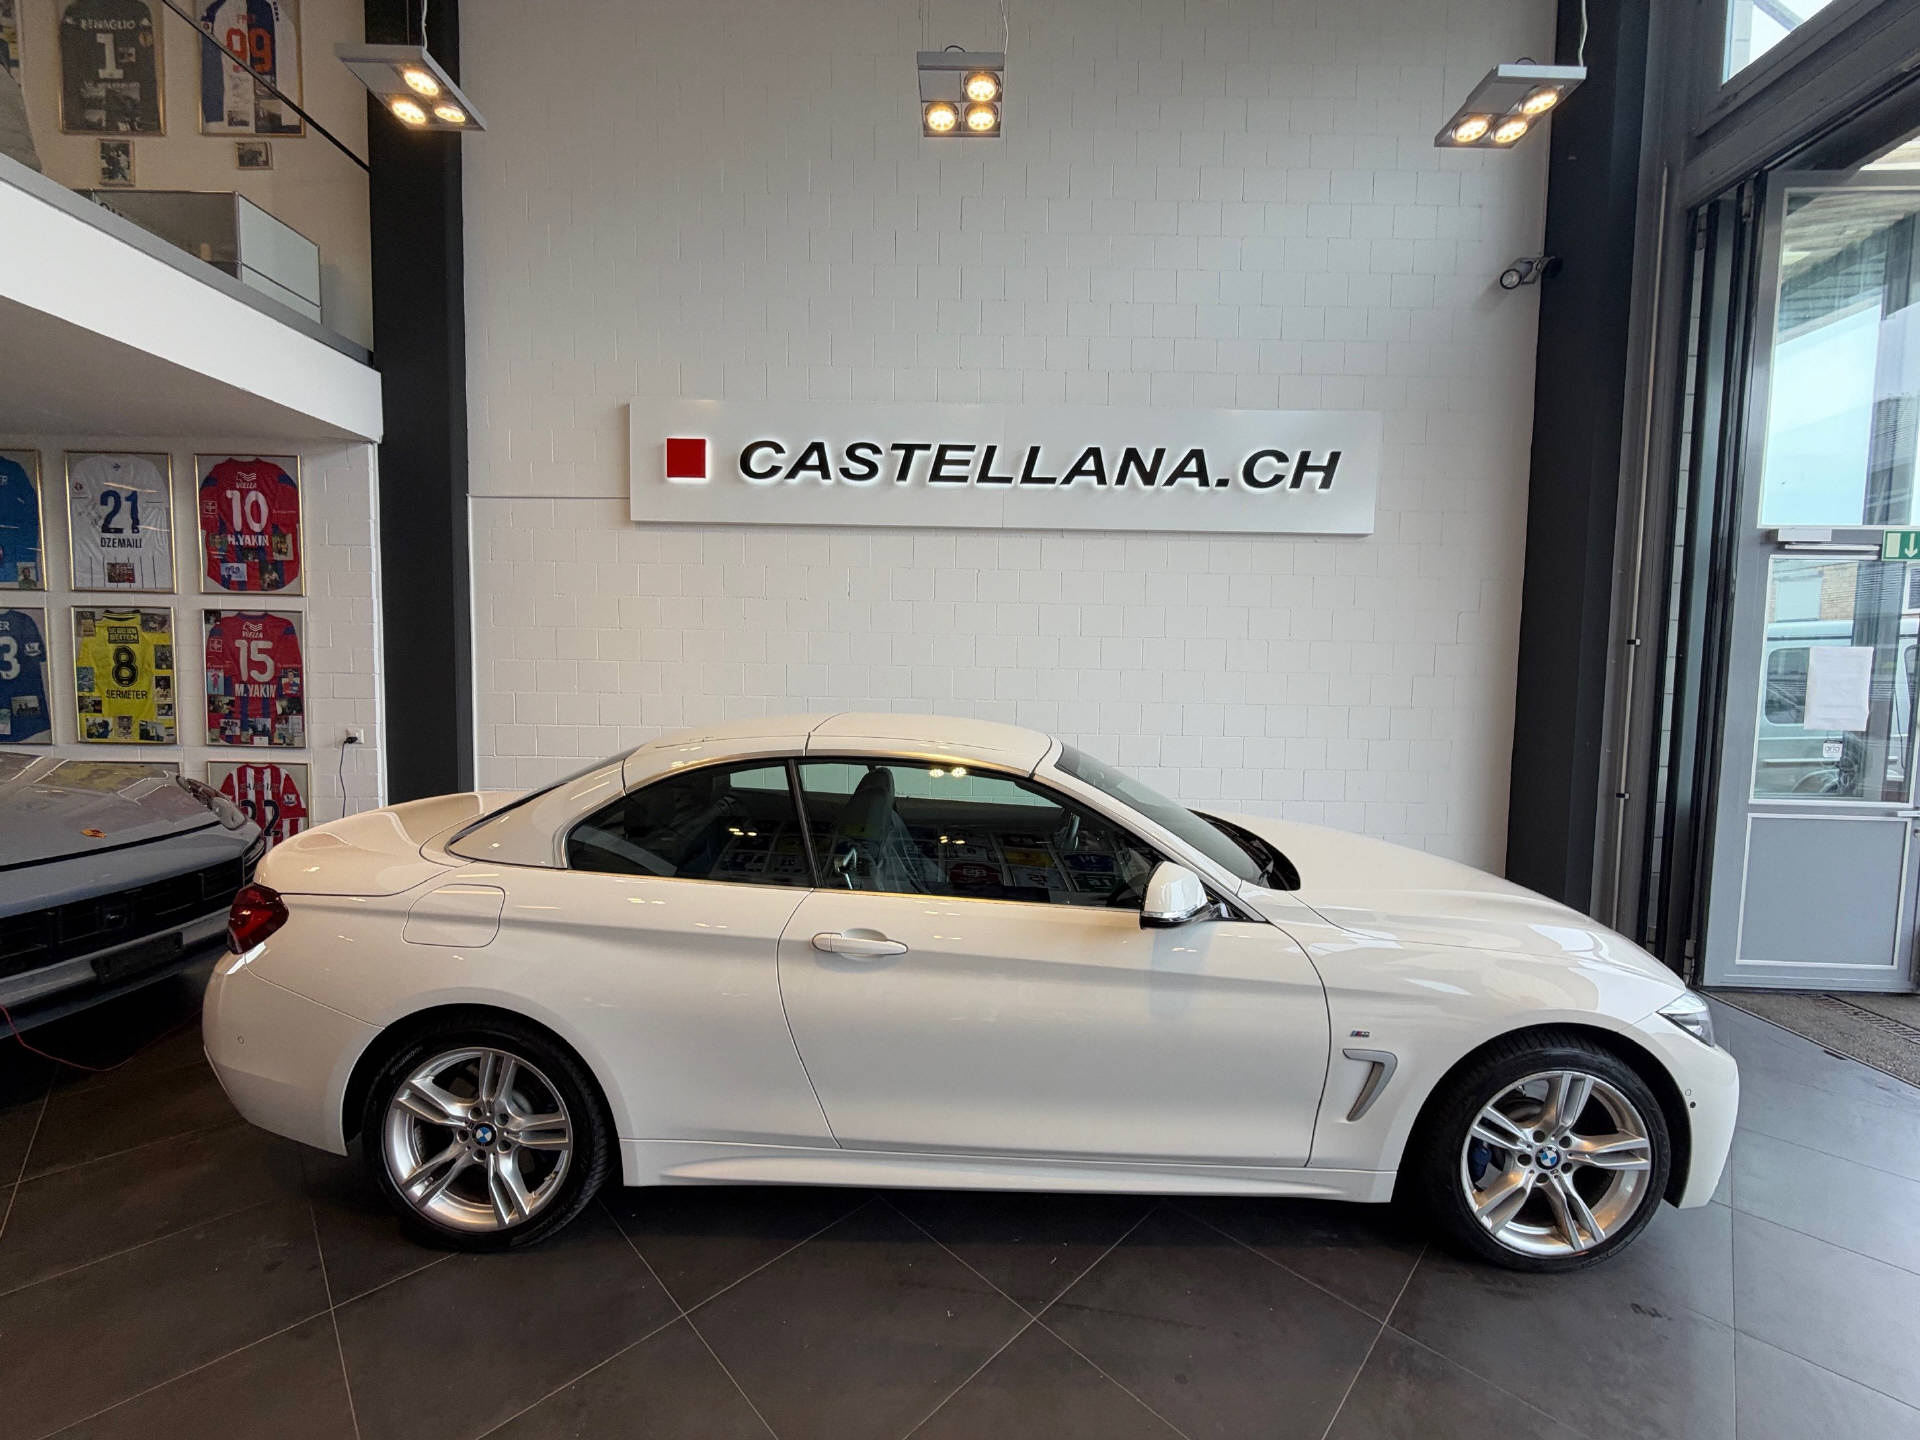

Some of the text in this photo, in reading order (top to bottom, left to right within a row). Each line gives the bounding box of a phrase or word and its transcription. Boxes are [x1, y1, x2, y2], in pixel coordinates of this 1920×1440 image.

[96, 33, 124, 79] 1
[226, 27, 273, 73] 99
[738, 440, 1342, 490] CASTELLANA.CH
[100, 489, 140, 534] 21
[226, 489, 269, 533] 10
[112, 645, 139, 688] 8
[234, 639, 275, 683] 15
[105, 688, 148, 700] SERMETER
